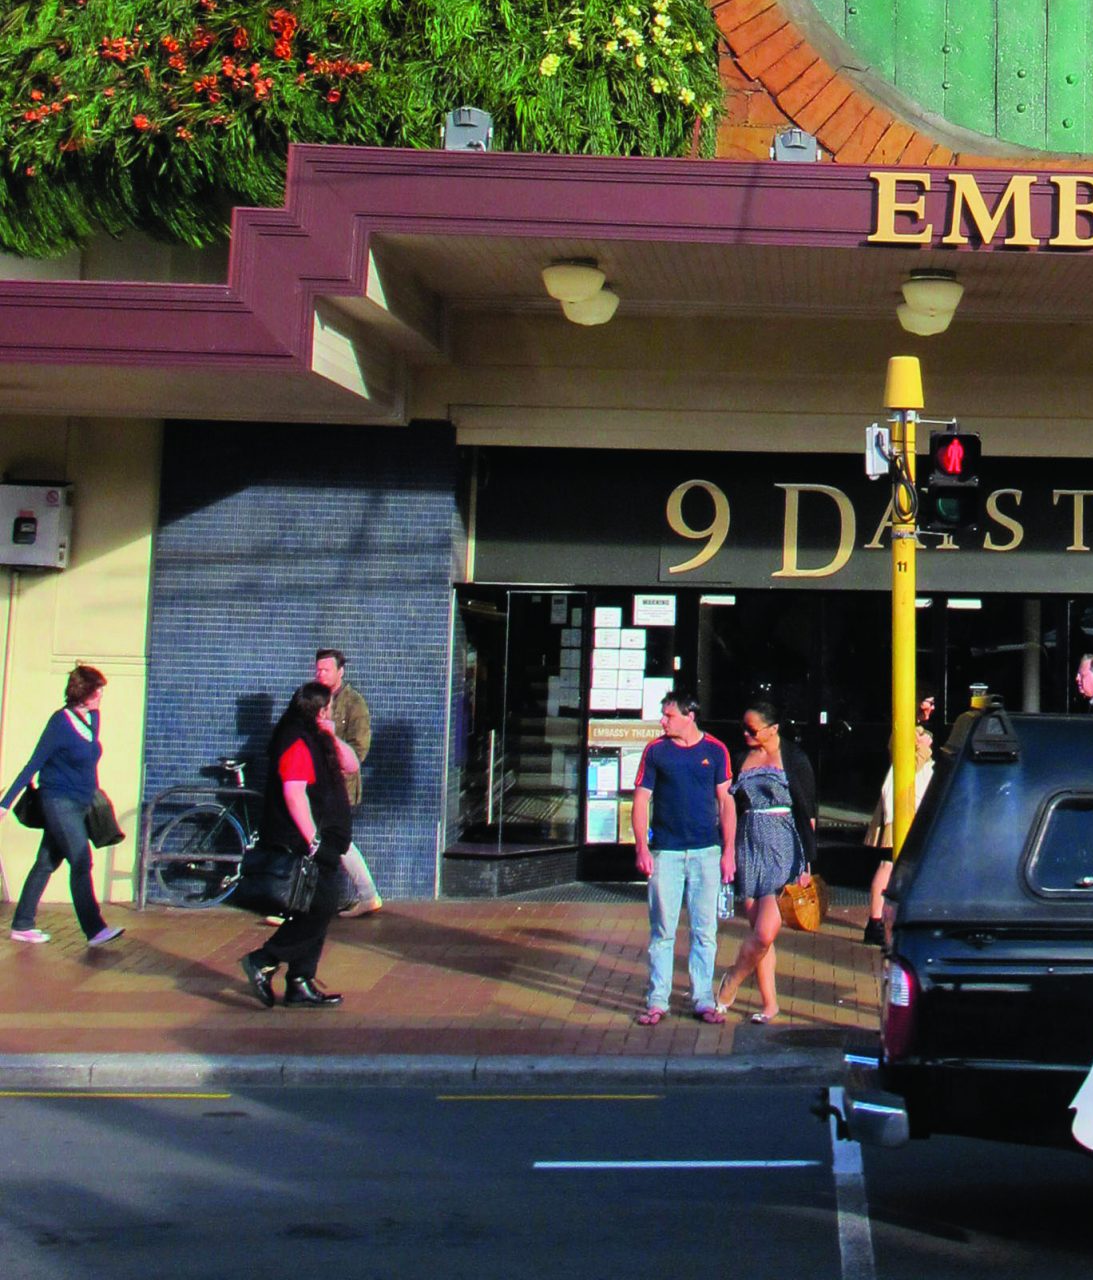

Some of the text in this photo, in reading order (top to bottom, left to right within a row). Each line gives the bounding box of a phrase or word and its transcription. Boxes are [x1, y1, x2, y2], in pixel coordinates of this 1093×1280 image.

[665, 478, 732, 574] 9
[773, 482, 1026, 579] DAS
[896, 560, 908, 573] 11
[592, 728, 629, 738] EMBASSY
